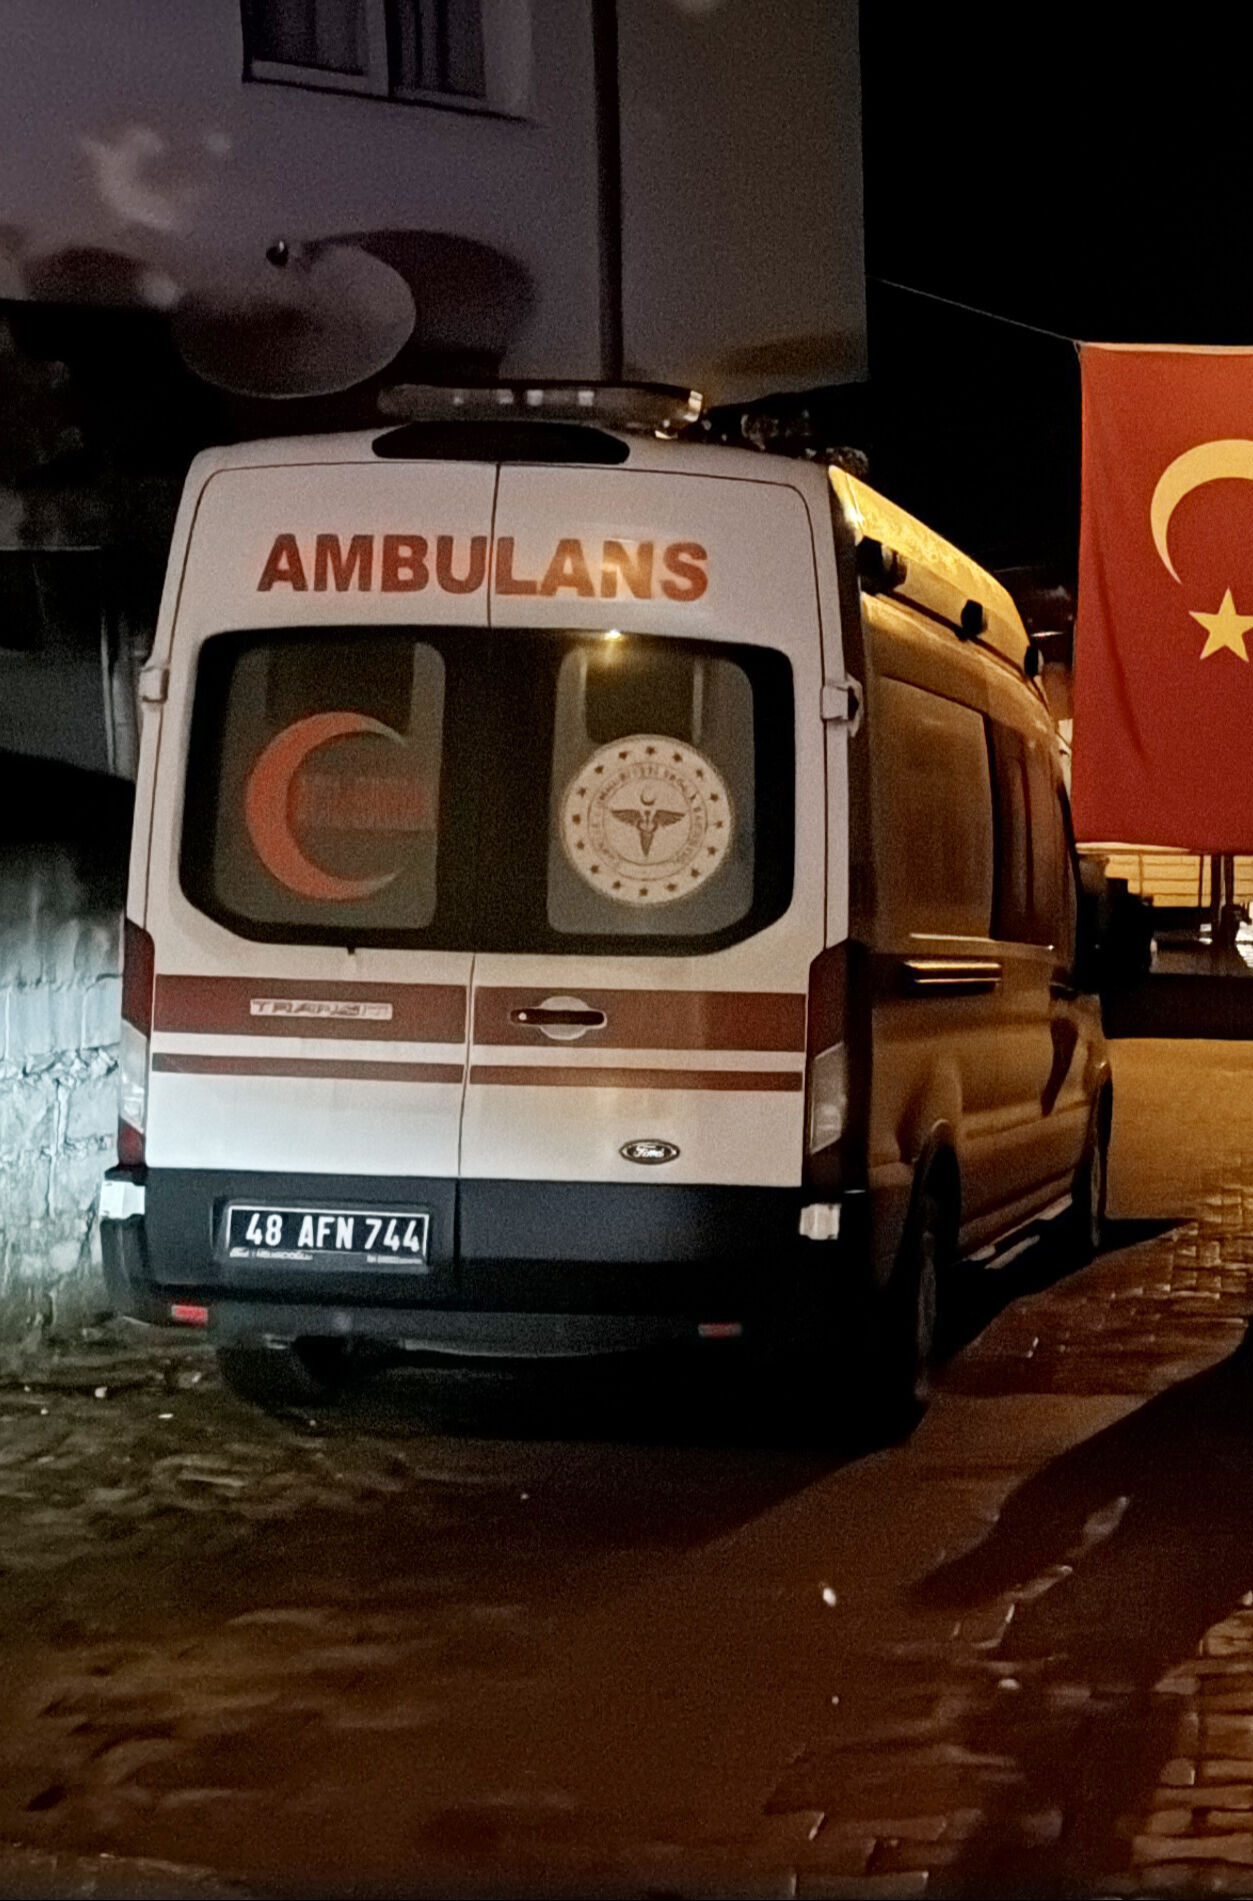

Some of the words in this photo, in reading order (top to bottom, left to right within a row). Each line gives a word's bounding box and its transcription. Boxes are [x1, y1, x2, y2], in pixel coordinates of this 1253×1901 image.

[257, 533, 709, 601] AMBULANS
[245, 1213, 283, 1246] 48
[297, 1215, 355, 1249] AFN
[364, 1218, 420, 1252] 744
